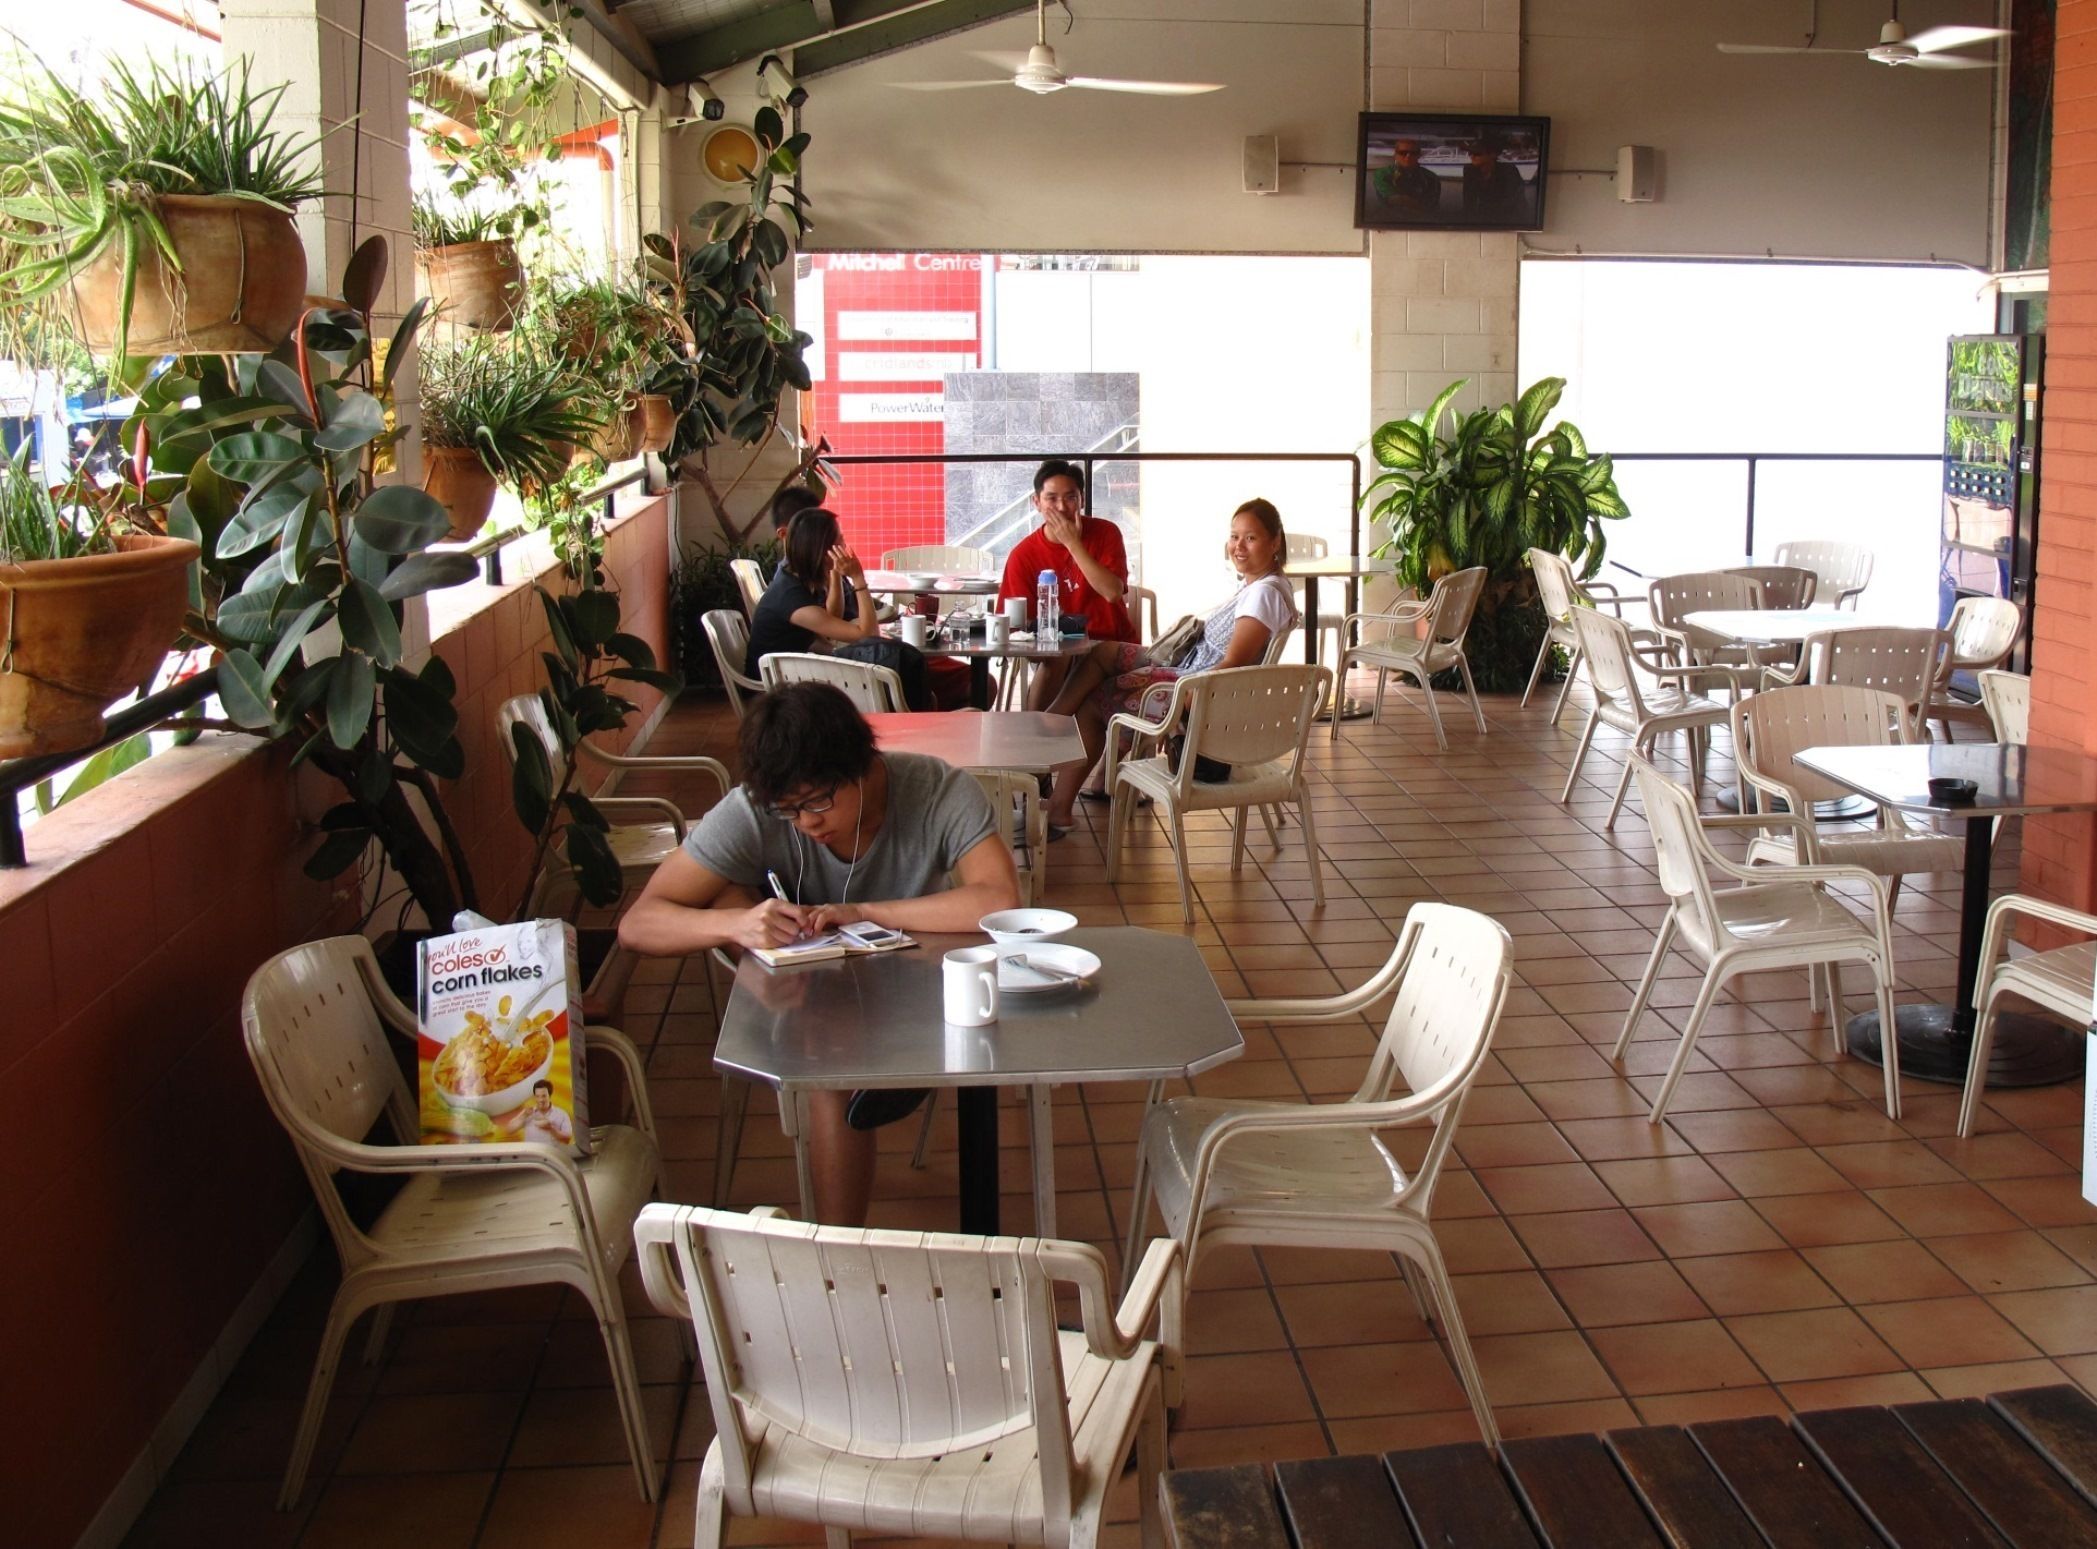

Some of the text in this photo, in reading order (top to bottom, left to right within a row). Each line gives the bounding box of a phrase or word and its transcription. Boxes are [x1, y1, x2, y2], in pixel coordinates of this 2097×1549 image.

[829, 253, 981, 271] Mitchell Centre
[459, 937, 481, 952] love
[432, 953, 483, 975] coles
[432, 964, 543, 994] corn flakes
